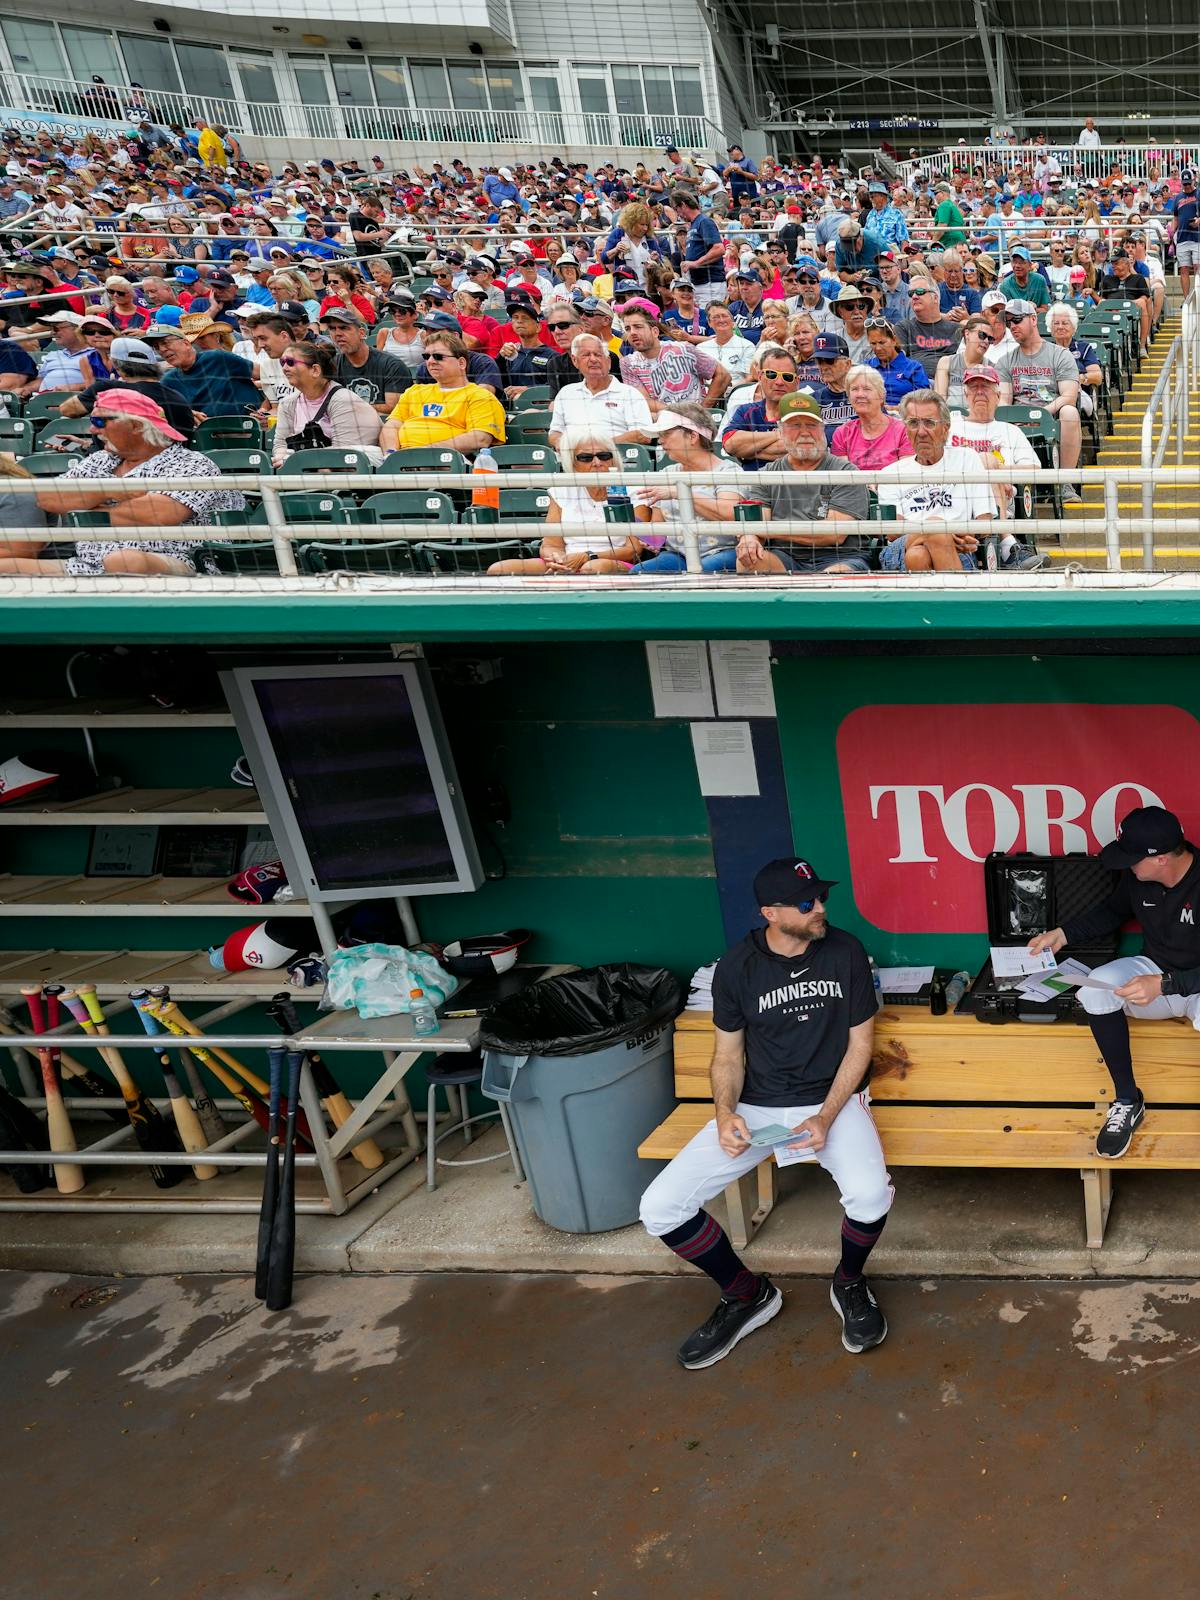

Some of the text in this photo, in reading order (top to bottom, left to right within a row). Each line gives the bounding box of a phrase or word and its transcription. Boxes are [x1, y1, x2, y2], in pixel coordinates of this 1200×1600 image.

[10, 117, 78, 137] ROADS
[857, 120, 870, 128] 213
[880, 120, 909, 128] SECTION
[656, 135, 672, 145] 213
[1052, 152, 1069, 162] 214
[98, 225, 114, 233] 213
[915, 335, 953, 347] Gators
[1012, 366, 1052, 377] MINNESOTA
[819, 402, 857, 424] Twin
[951, 435, 992, 448] SPRING
[1180, 908, 1195, 925] M
[758, 980, 844, 1014] MINNESOTA
[782, 1002, 825, 1015] BASEBALL
[416, 1016, 425, 1024] G
